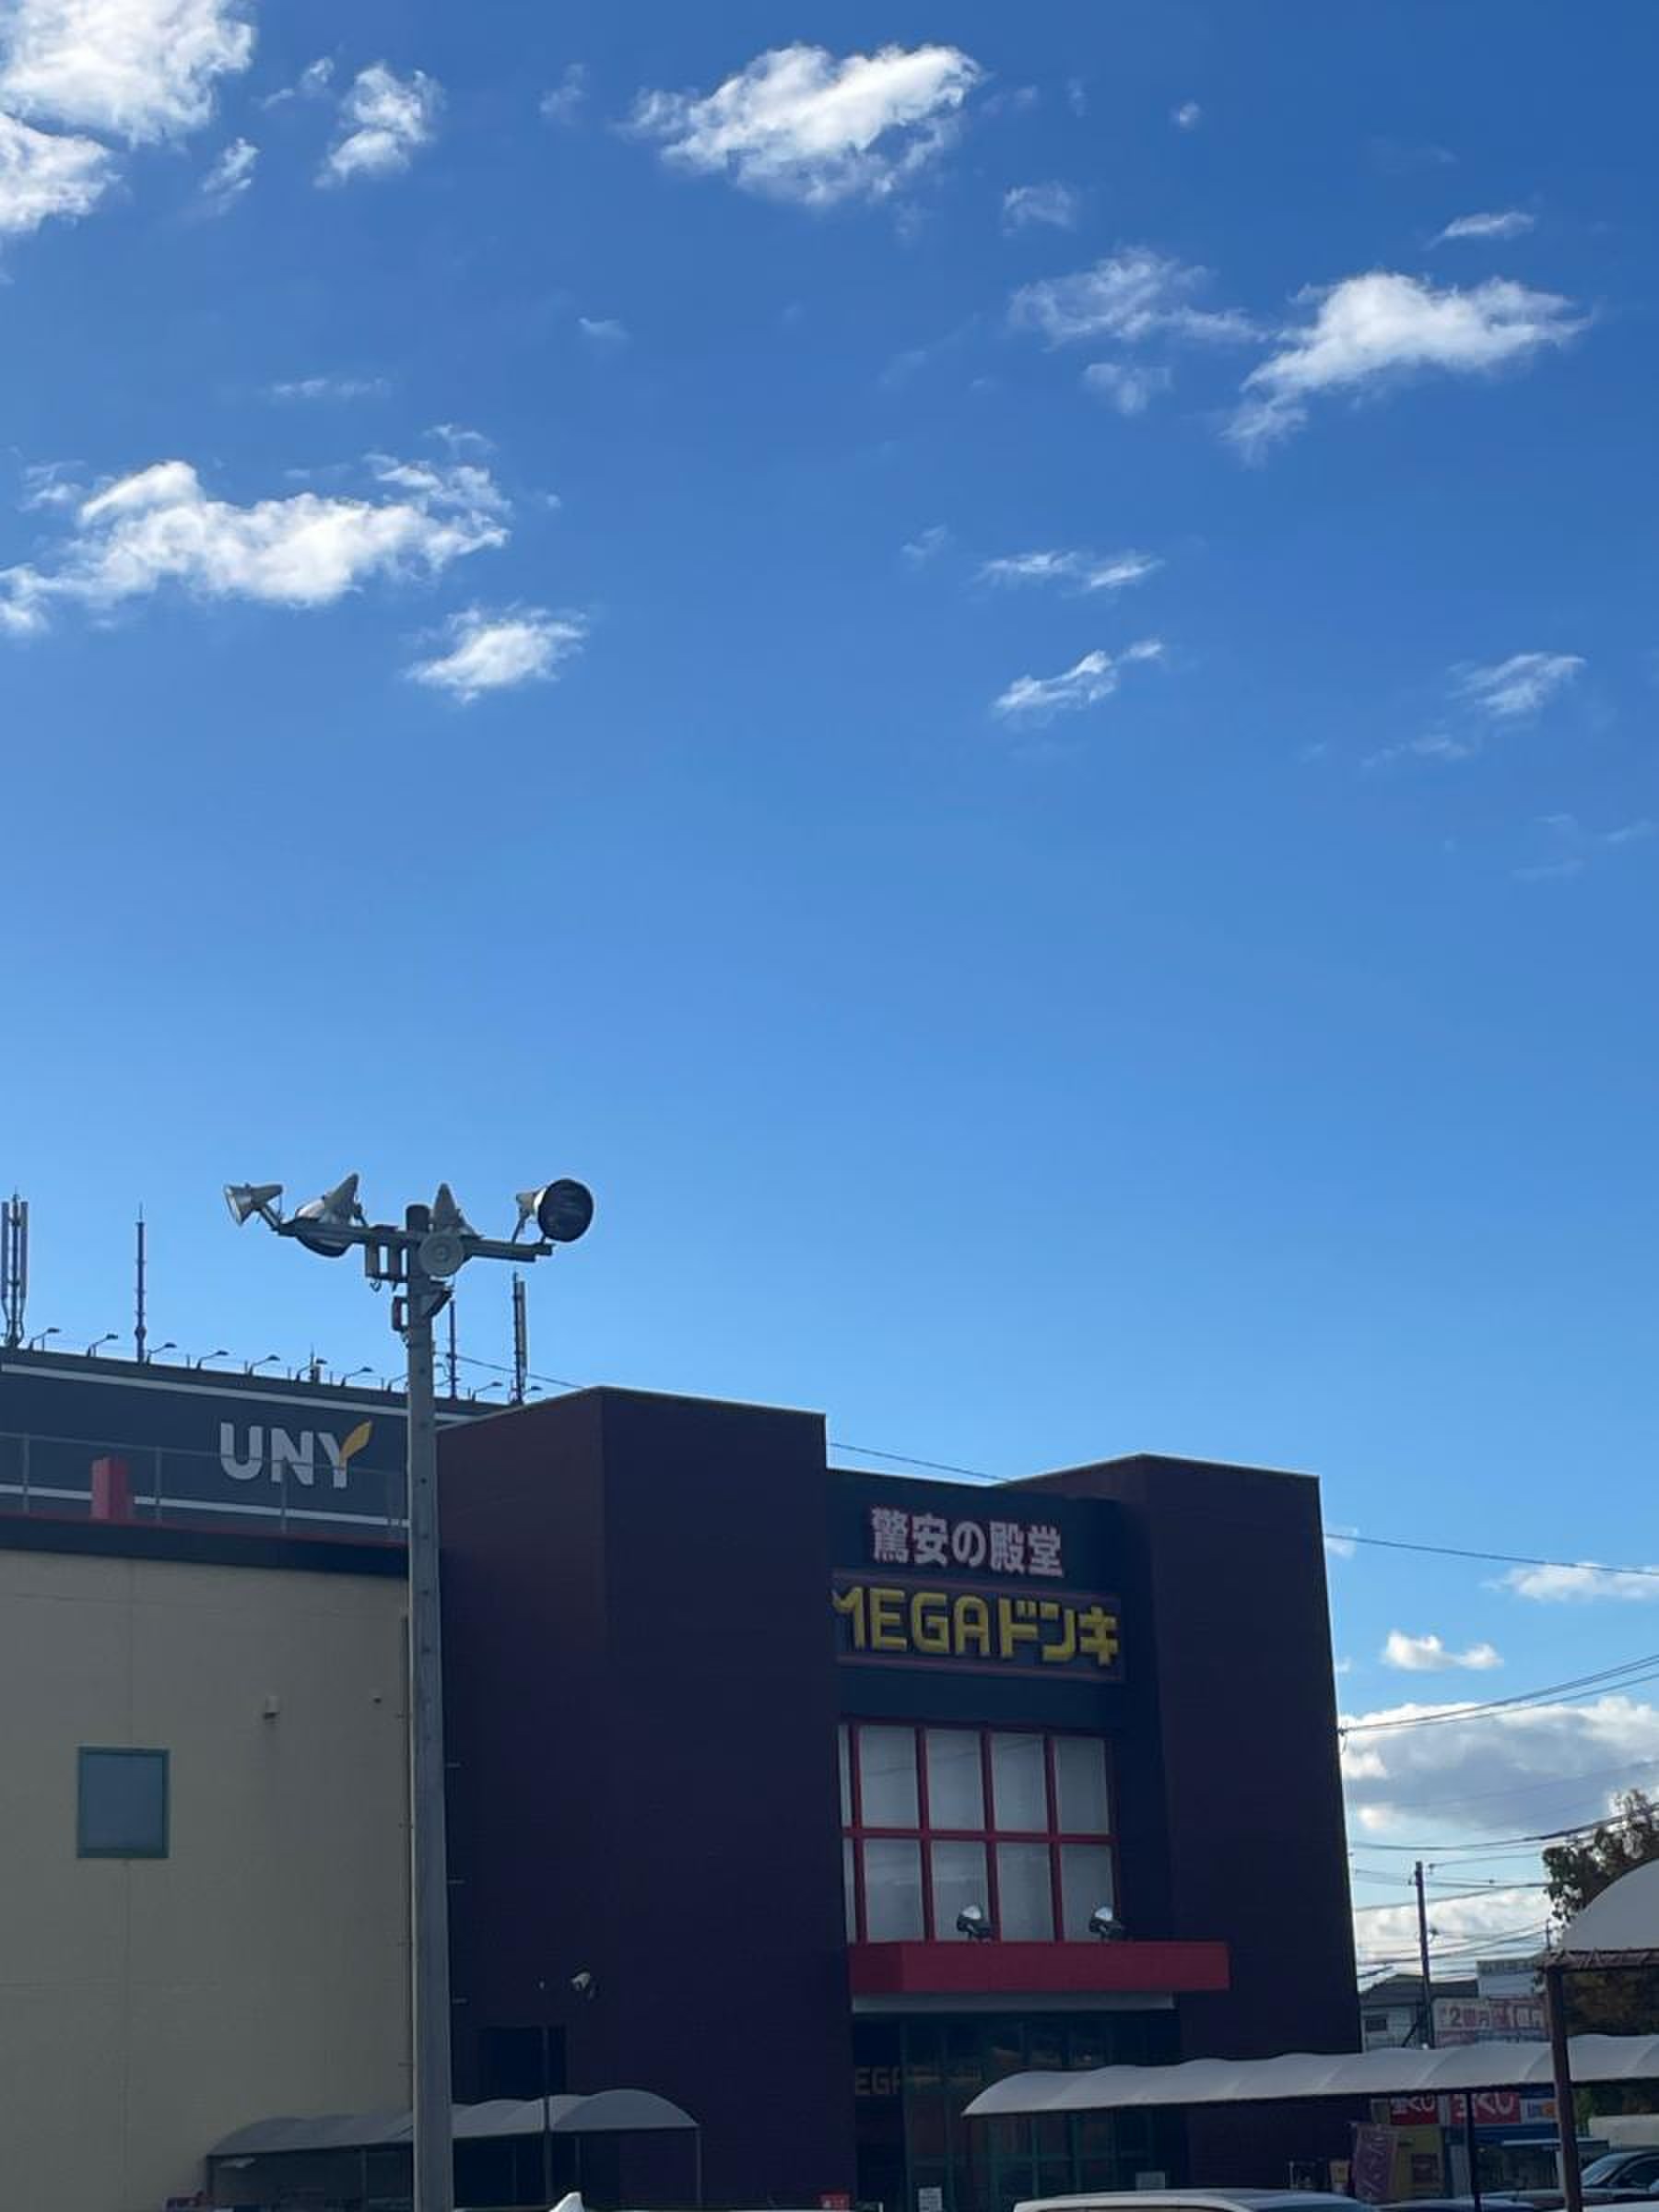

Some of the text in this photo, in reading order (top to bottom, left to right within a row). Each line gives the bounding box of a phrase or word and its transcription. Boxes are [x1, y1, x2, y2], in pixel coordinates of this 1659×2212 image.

[219, 1420, 372, 1489] UNY
[871, 1507, 1064, 1578] 驚安の殿堂
